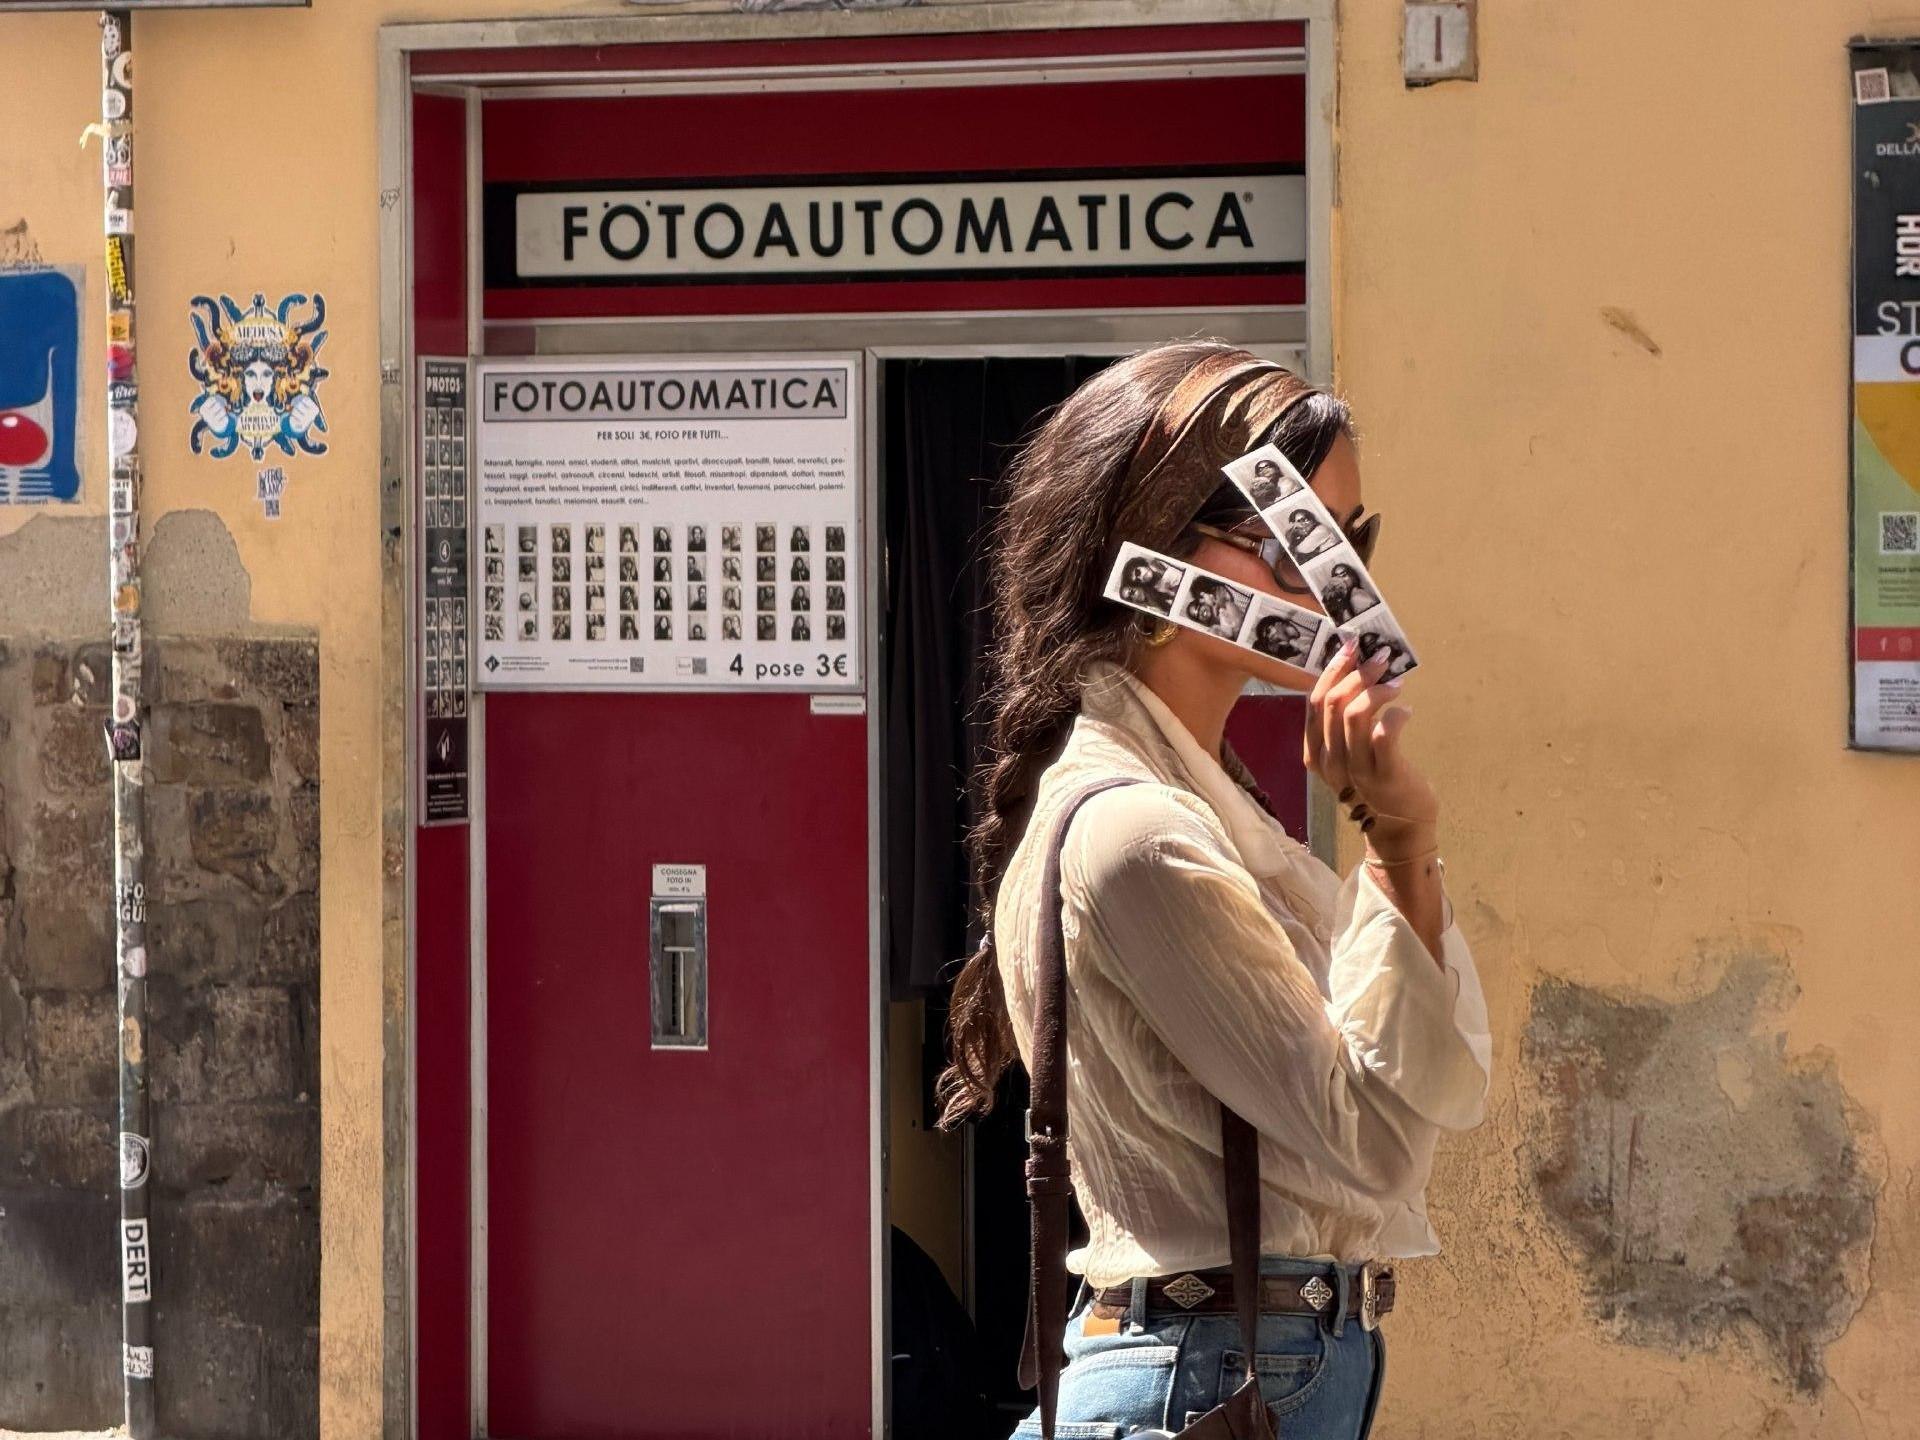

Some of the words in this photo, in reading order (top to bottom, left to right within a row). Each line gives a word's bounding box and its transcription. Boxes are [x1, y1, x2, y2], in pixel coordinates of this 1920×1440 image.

[237, 326, 284, 338] MEDUSA
[597, 431, 612, 440] PER
[615, 431, 635, 440] SOLI
[655, 430, 680, 440] FOTO
[682, 429, 697, 440] PER
[729, 653, 744, 676] 4
[755, 661, 805, 680] pose
[816, 653, 848, 677] 3€
[660, 868, 697, 876] CONSEGNA
[667, 876, 683, 884] FOTO
[125, 1224, 148, 1296] DERT
